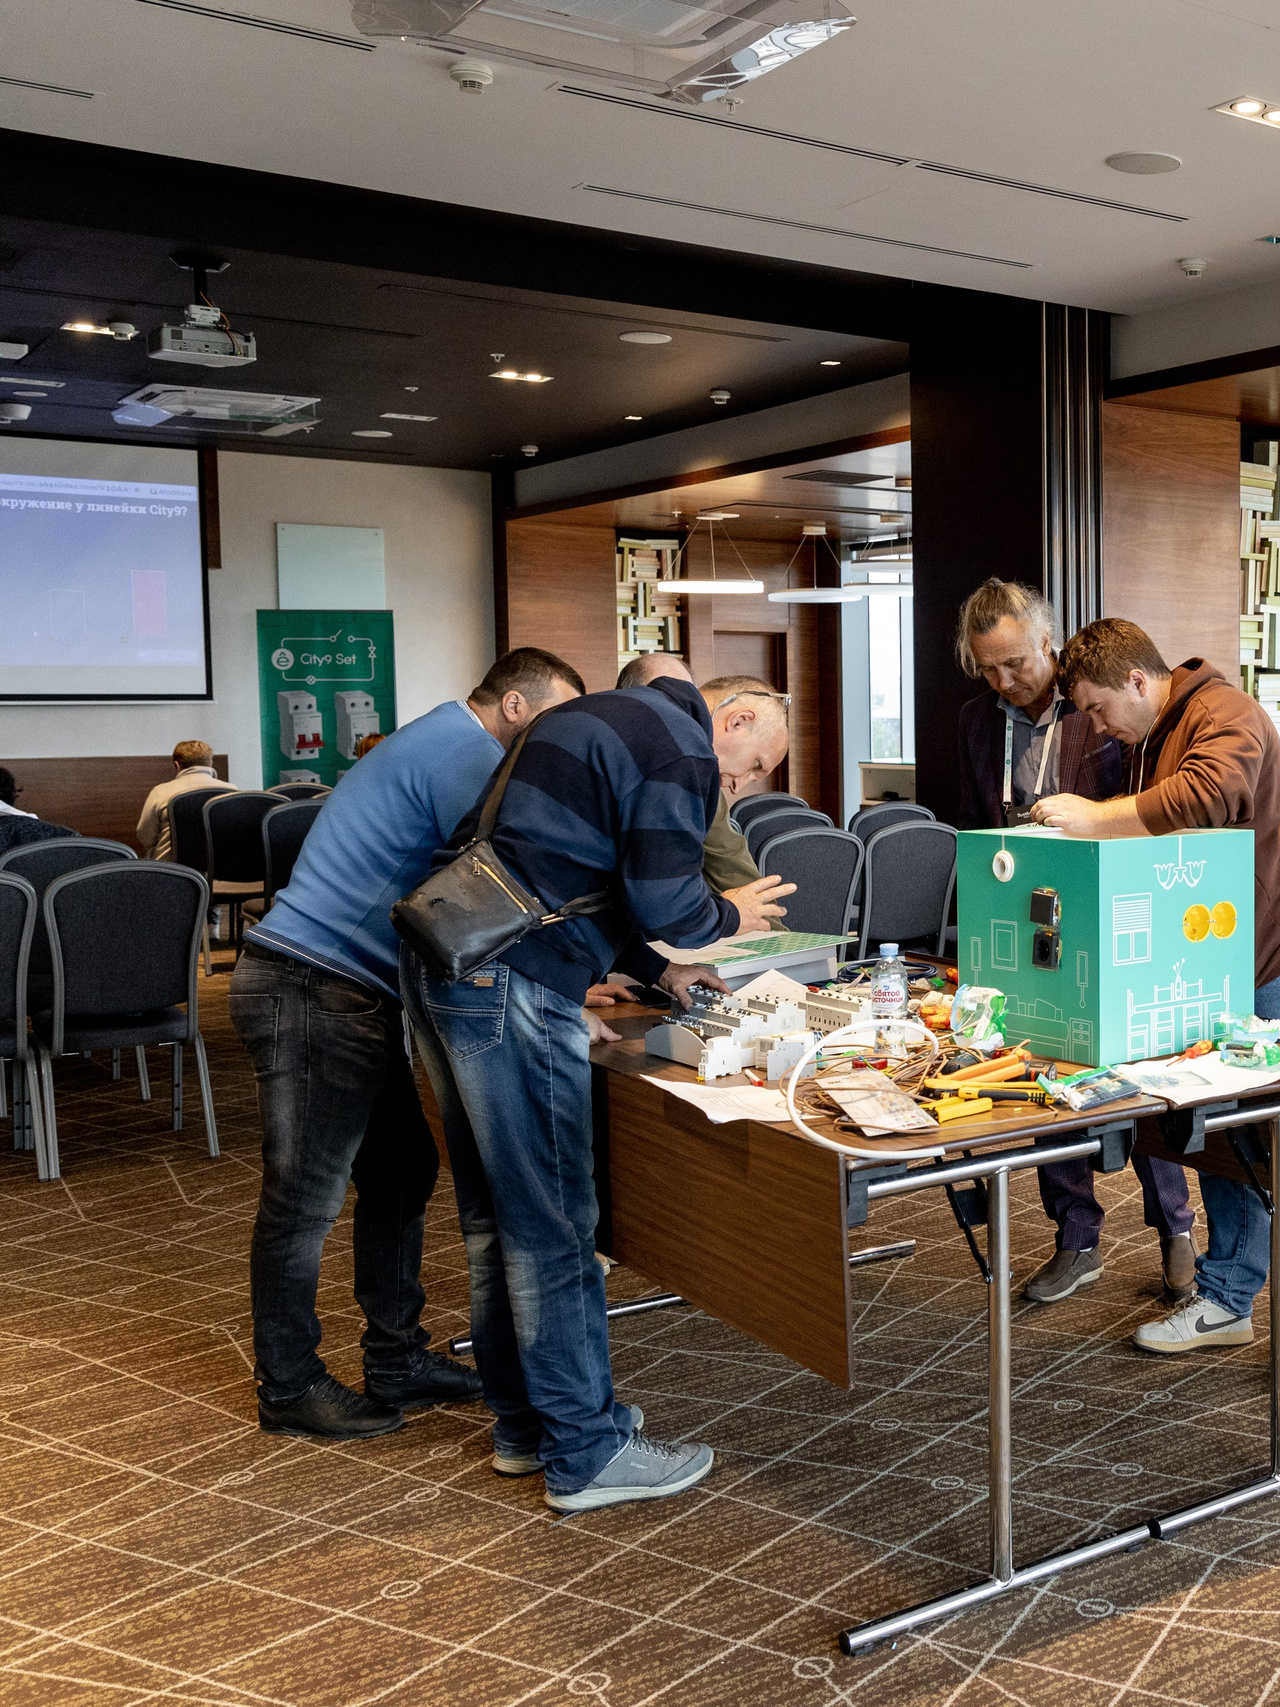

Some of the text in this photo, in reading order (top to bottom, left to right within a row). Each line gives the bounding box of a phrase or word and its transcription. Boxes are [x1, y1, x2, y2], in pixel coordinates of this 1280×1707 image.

[0, 498, 188, 518] кружение у линейки City9?
[300, 653, 357, 667] City9 Set
